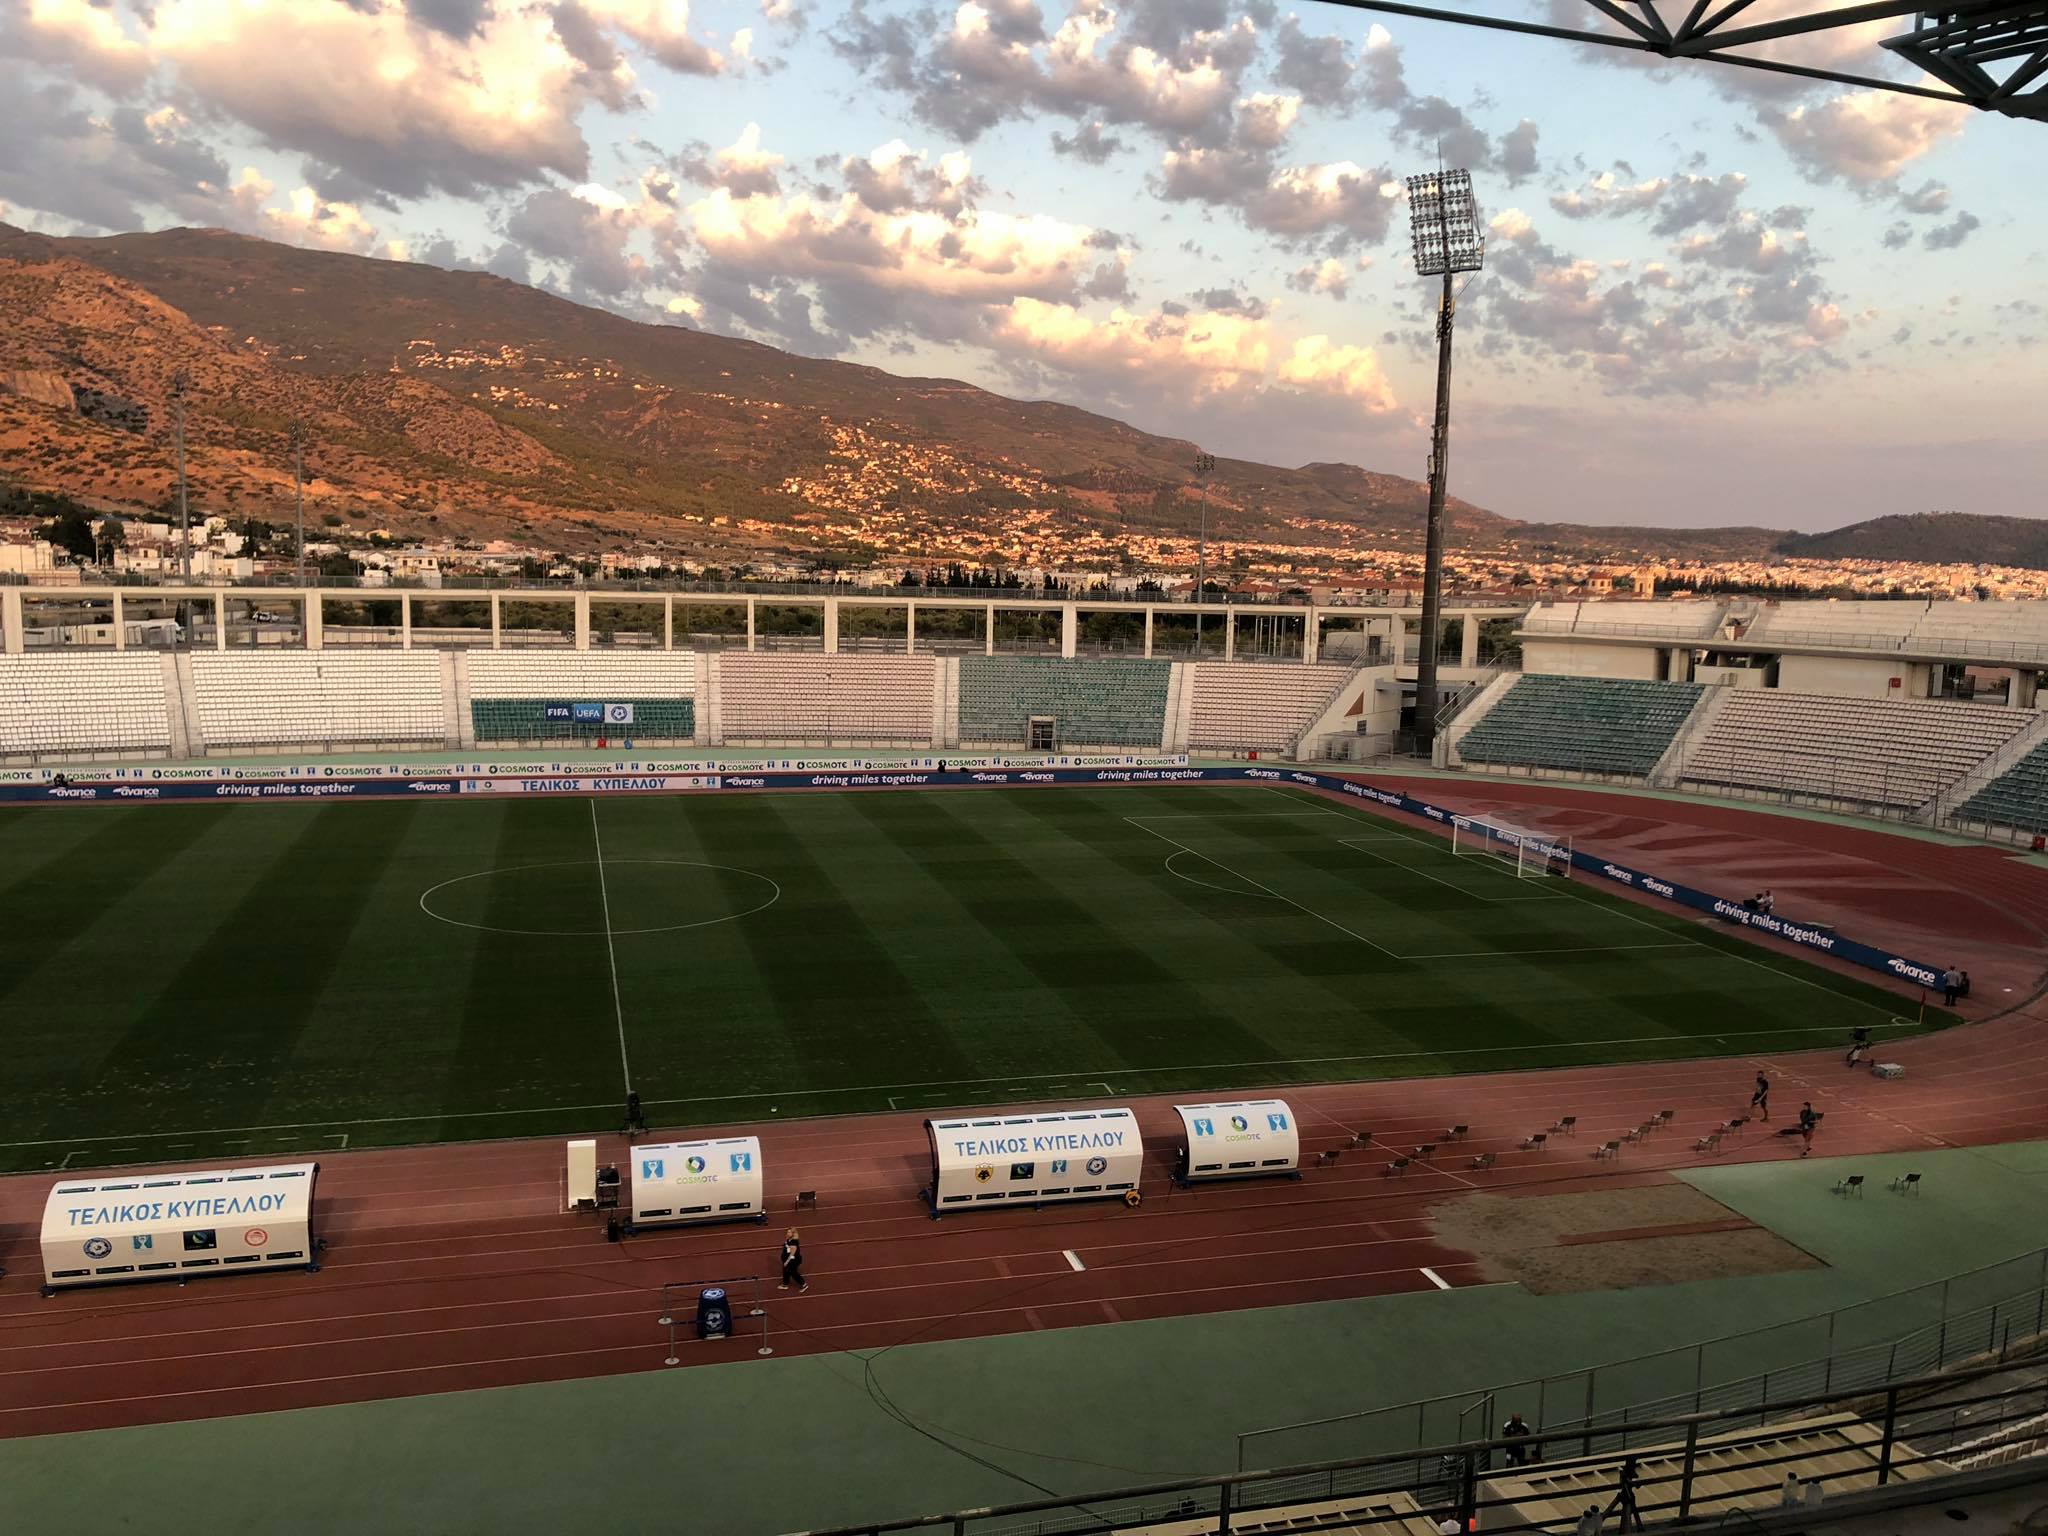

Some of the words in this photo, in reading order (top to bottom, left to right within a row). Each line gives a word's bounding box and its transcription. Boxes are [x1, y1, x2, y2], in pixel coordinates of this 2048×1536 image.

[547, 708, 569, 717] FIFA
[576, 708, 601, 718] UEFA
[812, 776, 848, 786] driving
[852, 774, 879, 784] miles
[882, 774, 928, 785] together
[1097, 770, 1130, 781] driving
[1132, 770, 1158, 779] miles
[1160, 770, 1204, 780] together
[216, 784, 260, 796] driving
[264, 784, 296, 794] miles
[300, 782, 355, 796] together
[521, 780, 580, 790] ΤΕΛΙΚΟΣ
[594, 778, 666, 789] ΚΥΠΕΛΛΟΥ
[1343, 782, 1363, 796] driving
[1362, 788, 1378, 799] miles
[1378, 792, 1402, 806] together
[1714, 900, 1750, 924] driving
[1752, 912, 1781, 932] miles
[1783, 922, 1835, 950] together
[1894, 958, 1936, 984] avance
[1225, 1133, 1261, 1142] COSMOTE
[955, 1137, 1029, 1157] ΤΕΛΙΚΟΣ
[1033, 1131, 1124, 1152] ΚΥΠΕΛΛΟΥ
[676, 1174, 718, 1184] COSMOTE
[68, 1202, 163, 1226] ΤΕΛΙΚΟΣ
[167, 1193, 286, 1220] ΚΥΠΕΛΛΟΥ
